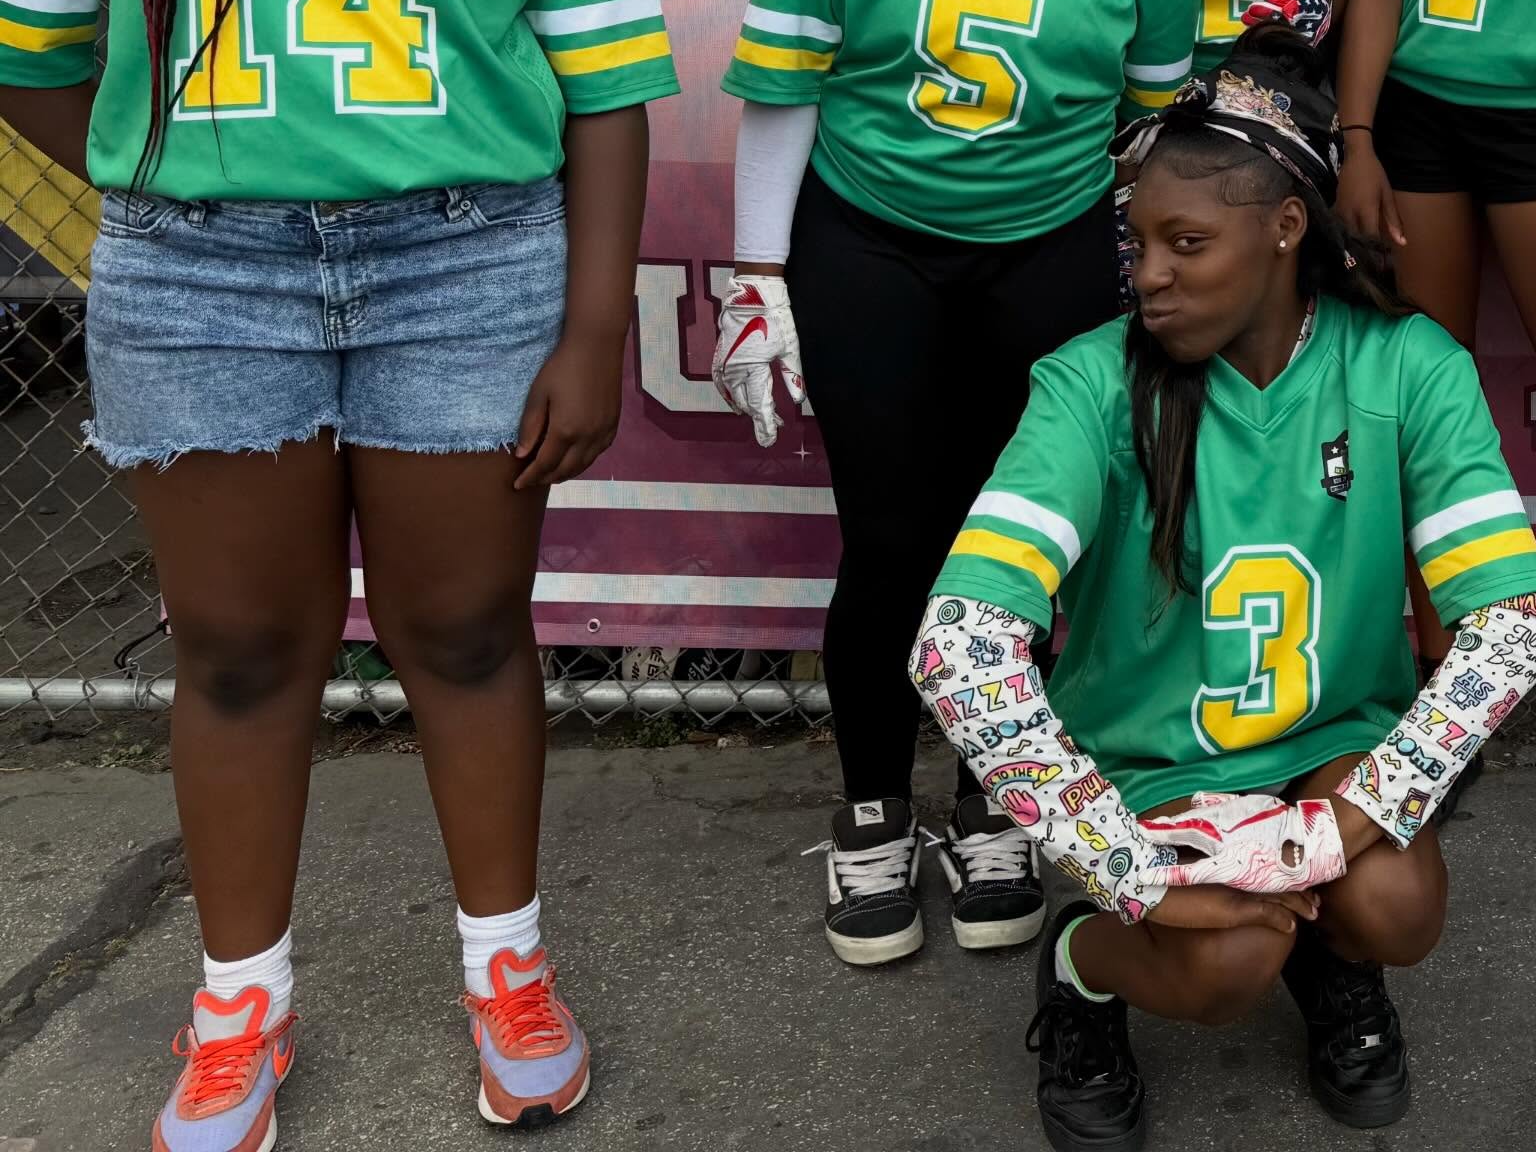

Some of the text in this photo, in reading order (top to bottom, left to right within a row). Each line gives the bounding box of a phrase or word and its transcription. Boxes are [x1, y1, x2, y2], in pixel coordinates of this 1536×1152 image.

[1191, 543, 1322, 756] 3
[1484, 642, 1526, 678] Bag
[1454, 667, 1496, 701] AS
[1010, 767, 1033, 779] THE
[1032, 822, 1056, 849] irl
